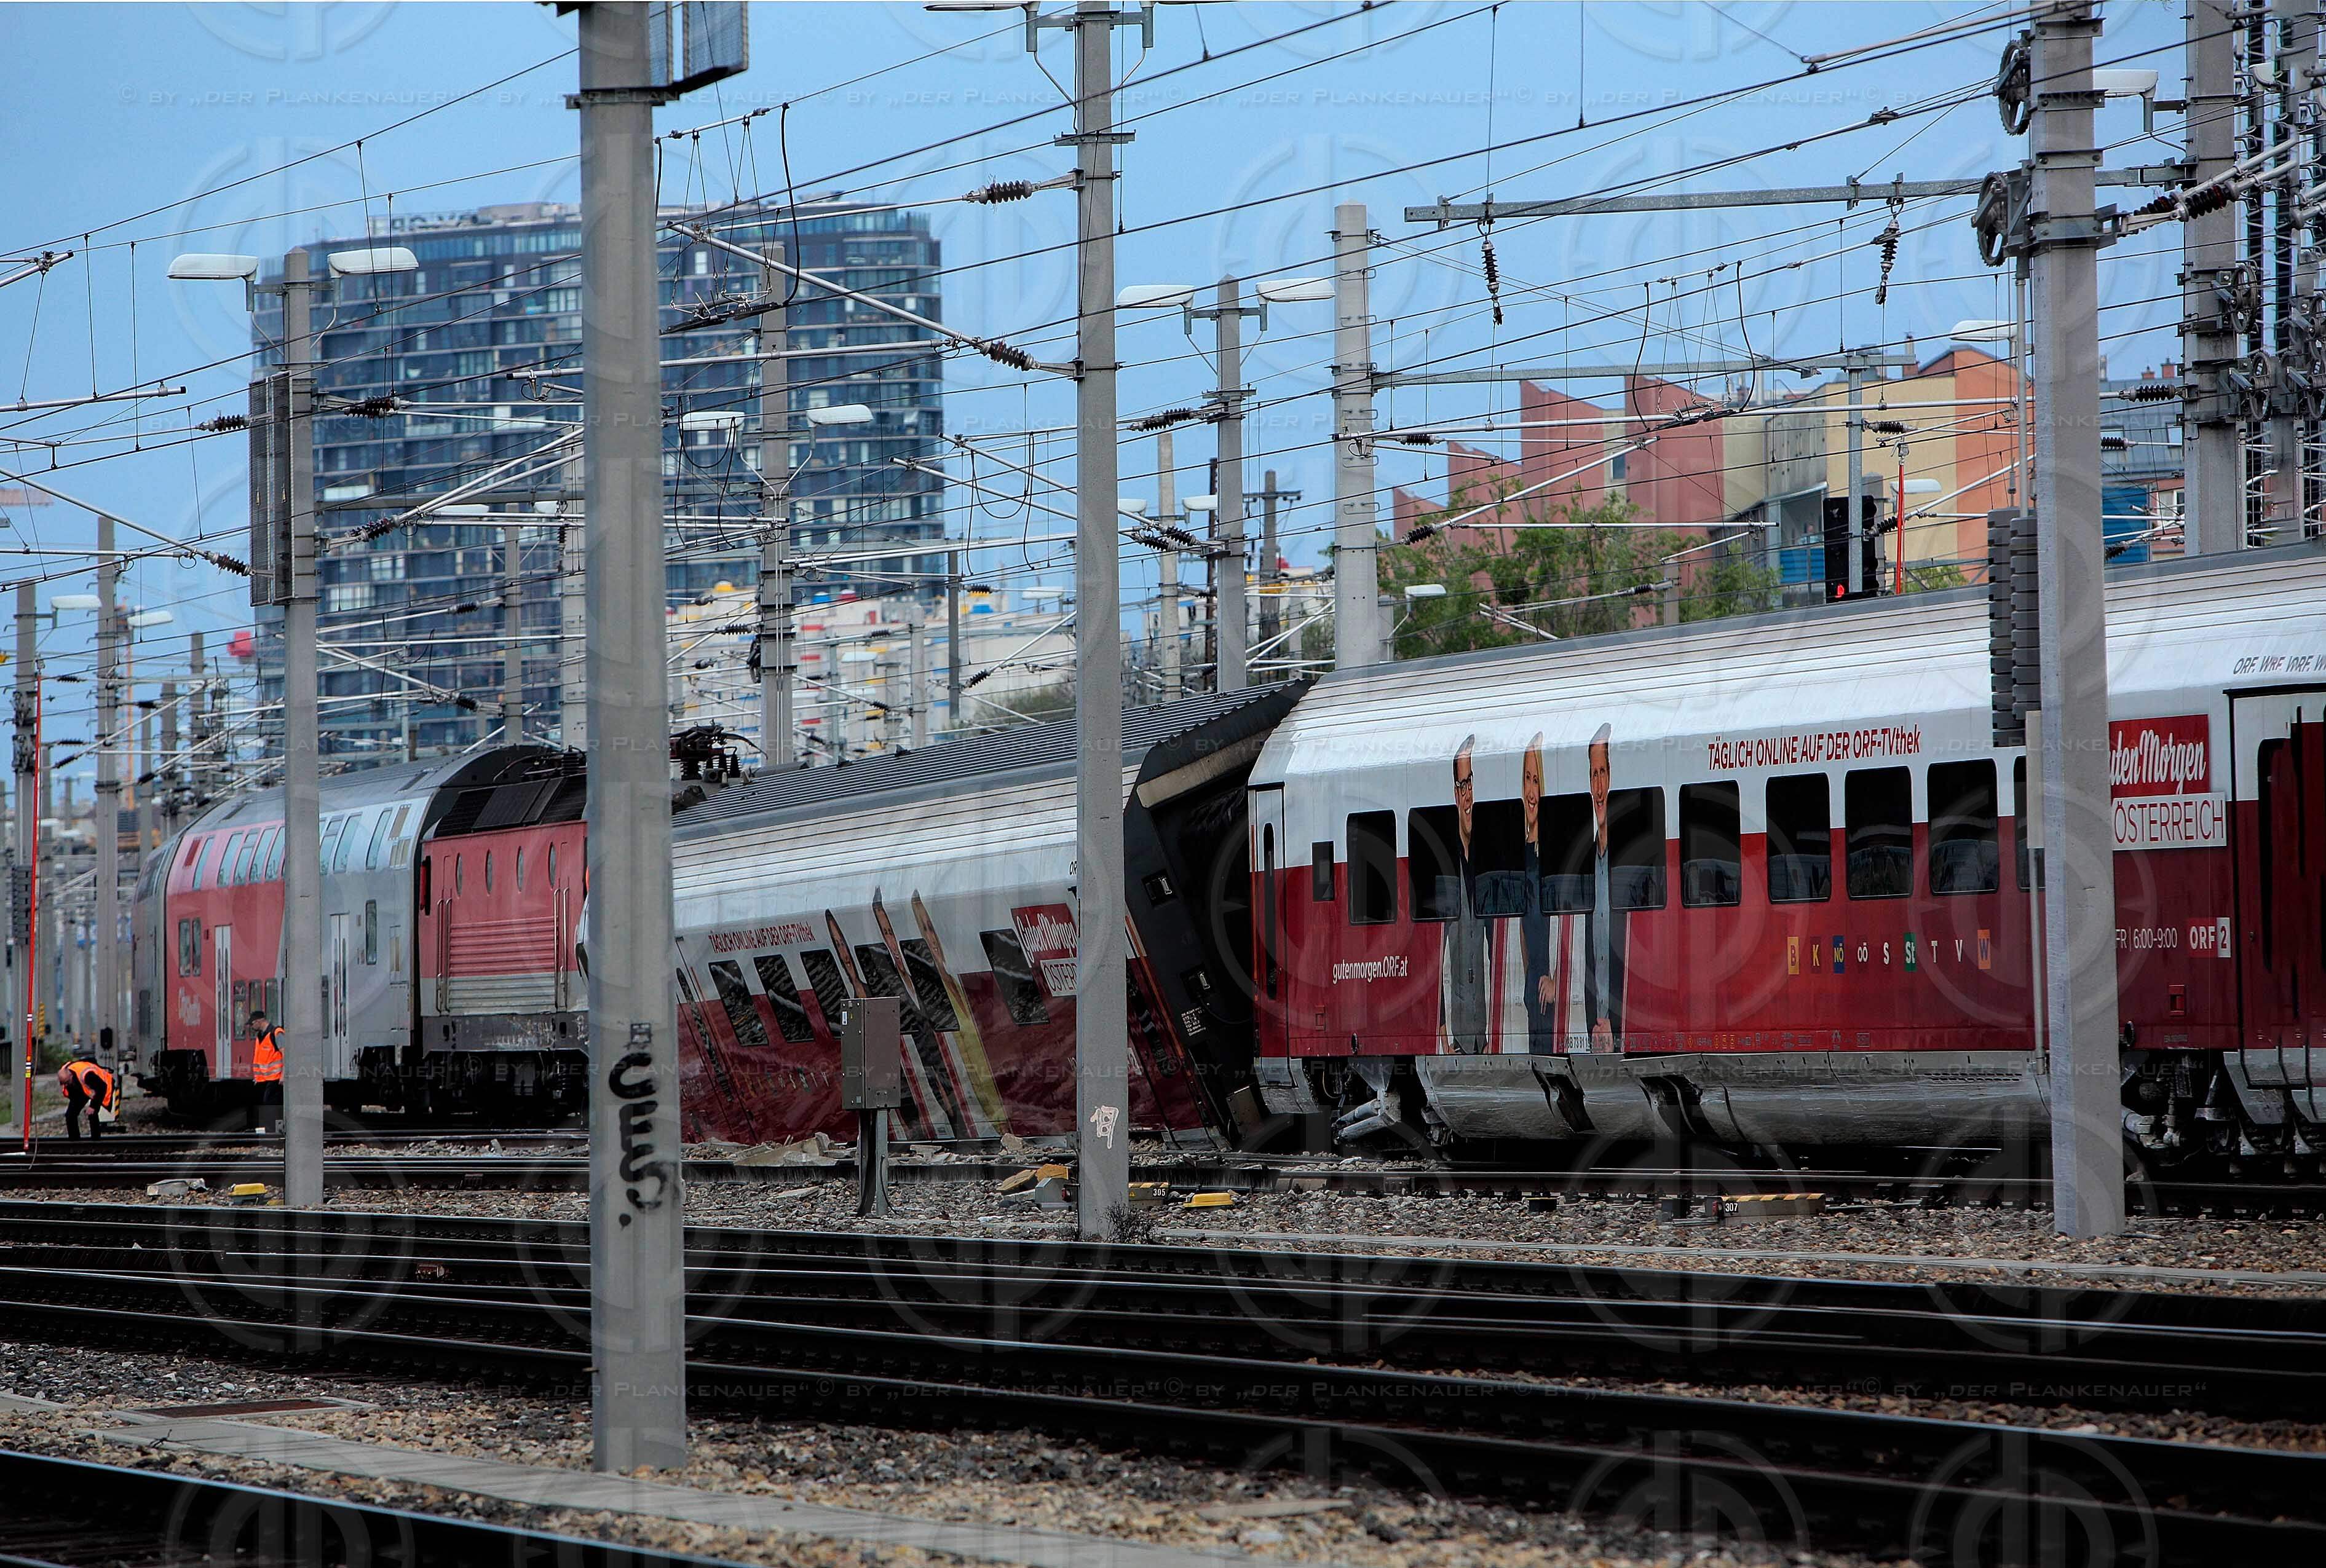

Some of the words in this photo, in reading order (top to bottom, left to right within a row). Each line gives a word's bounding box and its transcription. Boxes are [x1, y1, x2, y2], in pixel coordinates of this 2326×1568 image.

[1708, 736, 1753, 770] TÄGLICH
[1756, 736, 1798, 766] ONLINE
[1800, 733, 1824, 763] AUF
[1826, 731, 1850, 761] DER
[1853, 723, 1921, 758] ORF-TVthek
[2110, 730, 2141, 786] uten
[2139, 729, 2207, 795] Morgen
[2114, 800, 2224, 844] ÖSTERREICH
[2134, 928, 2178, 949] 6:00-9:00
[2190, 926, 2215, 950] ORF
[2220, 926, 2228, 949] 2
[1790, 945, 1797, 966] B
[1813, 944, 1820, 966] K
[1834, 943, 1844, 963] NÖ
[1883, 942, 1889, 964] S
[1905, 941, 1915, 963] St
[1931, 940, 1937, 963] T
[1955, 939, 1963, 962] V
[1332, 955, 1408, 984] gutenmorgen.ORF.at
[1725, 1203, 1738, 1212] 307
